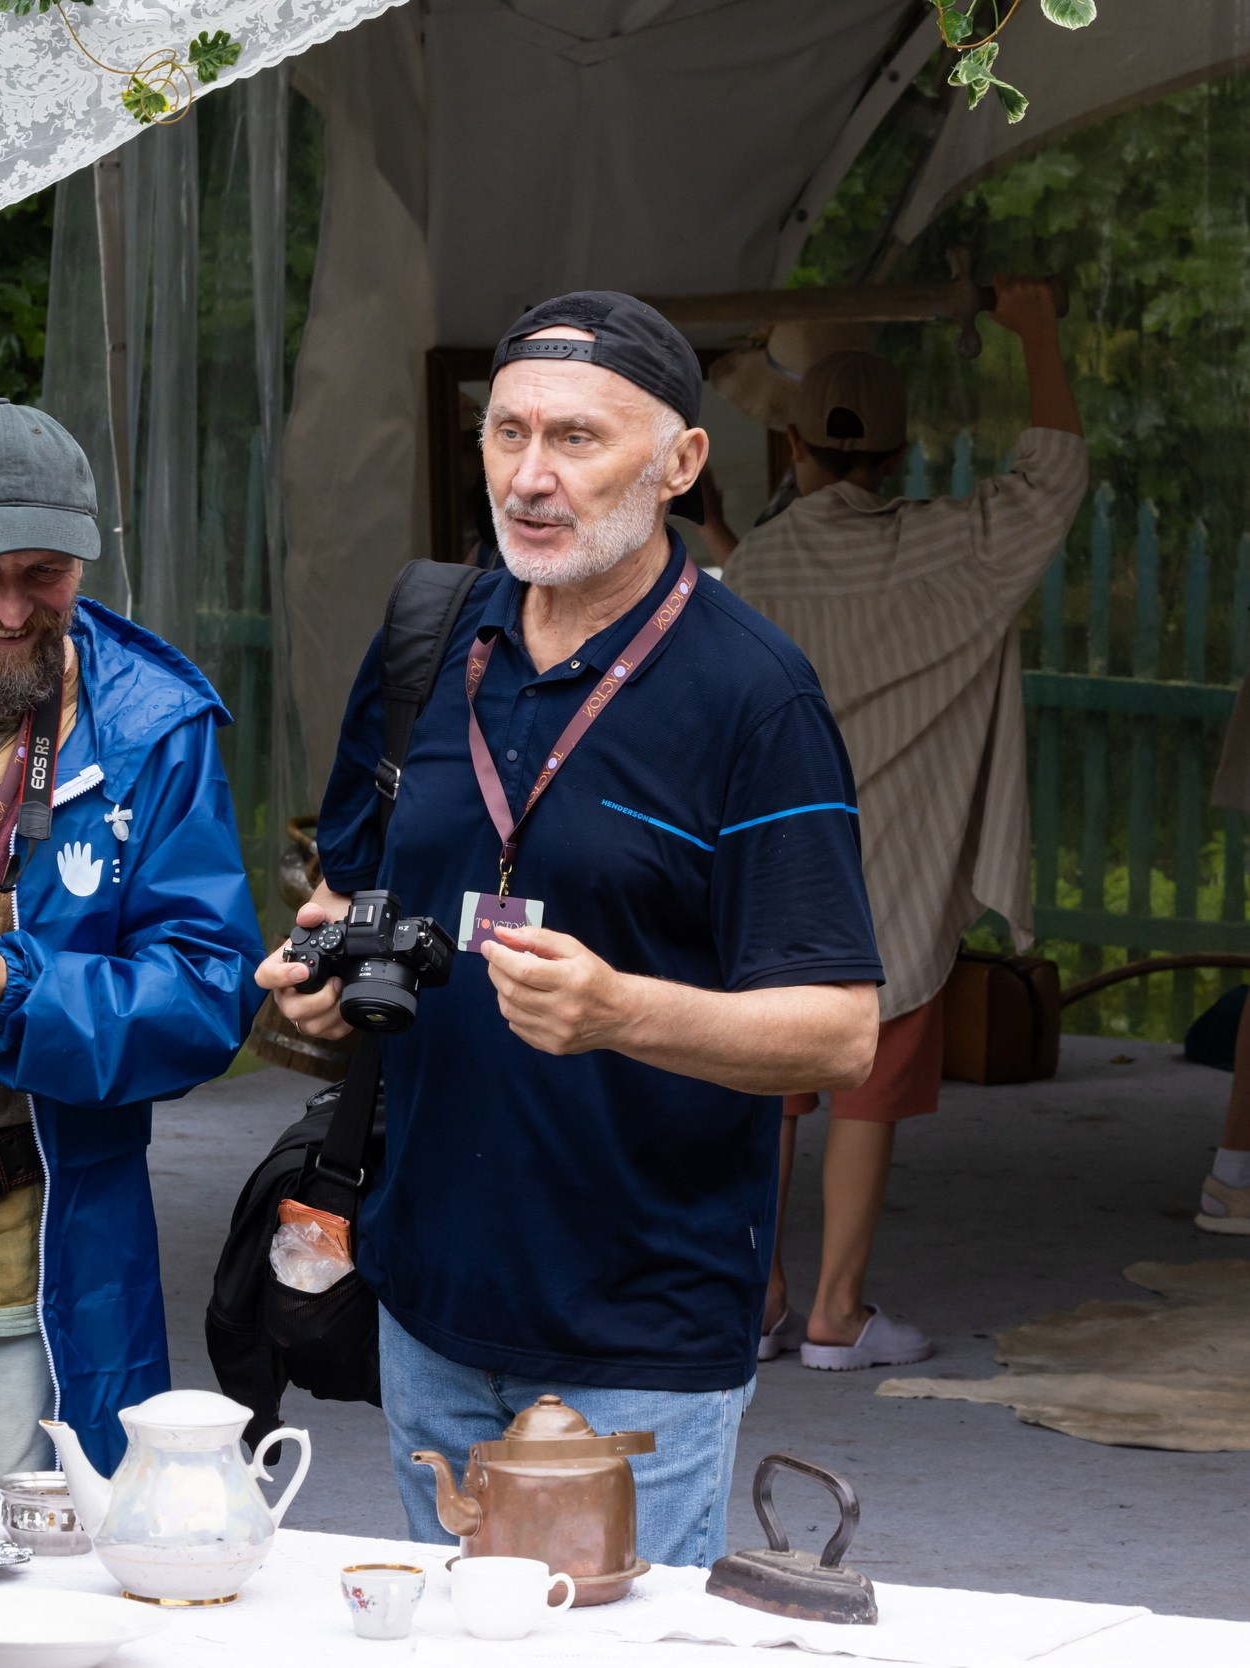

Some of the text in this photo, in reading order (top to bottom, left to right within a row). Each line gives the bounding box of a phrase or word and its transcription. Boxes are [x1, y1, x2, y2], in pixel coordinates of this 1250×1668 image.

[31, 736, 50, 790] EOS R5
[601, 799, 650, 822] HENDERSON
